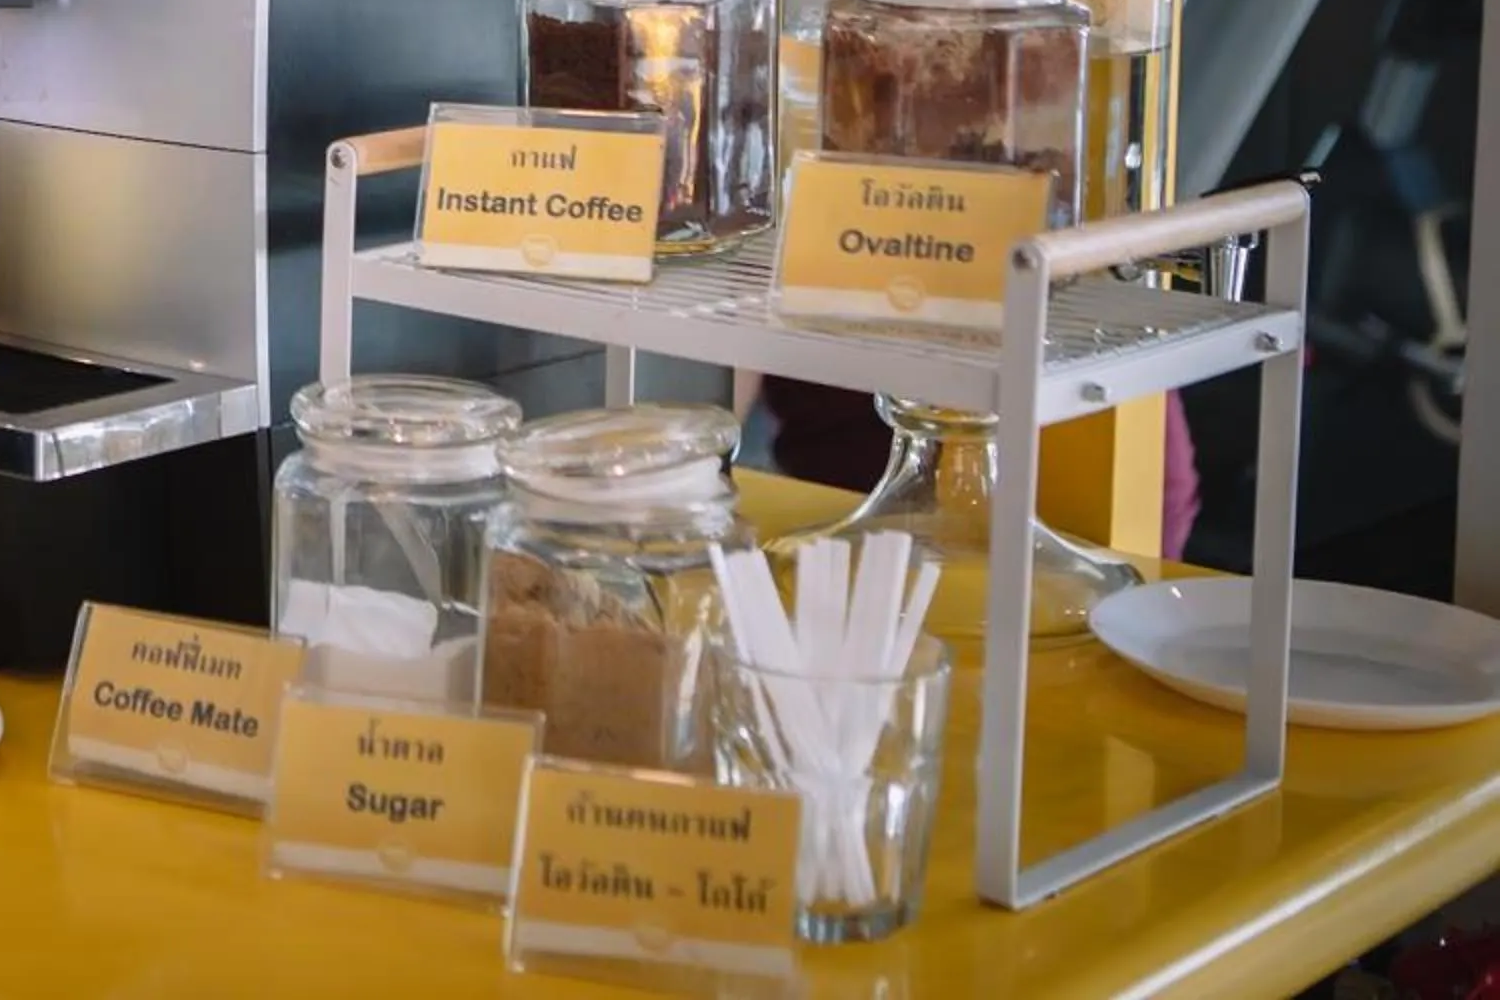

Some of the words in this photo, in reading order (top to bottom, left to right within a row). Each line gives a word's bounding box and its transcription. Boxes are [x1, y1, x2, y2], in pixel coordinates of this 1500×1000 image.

[510, 144, 578, 171] กาแฟ
[437, 187, 538, 217] Instant
[545, 193, 644, 223] Coffee
[860, 177, 966, 213] โอวัลติน
[839, 228, 976, 264] Ovaltine
[94, 680, 184, 722] Coffee
[190, 700, 259, 738] Mate
[358, 717, 445, 765] น้ำตาล
[346, 782, 445, 825] Sugar
